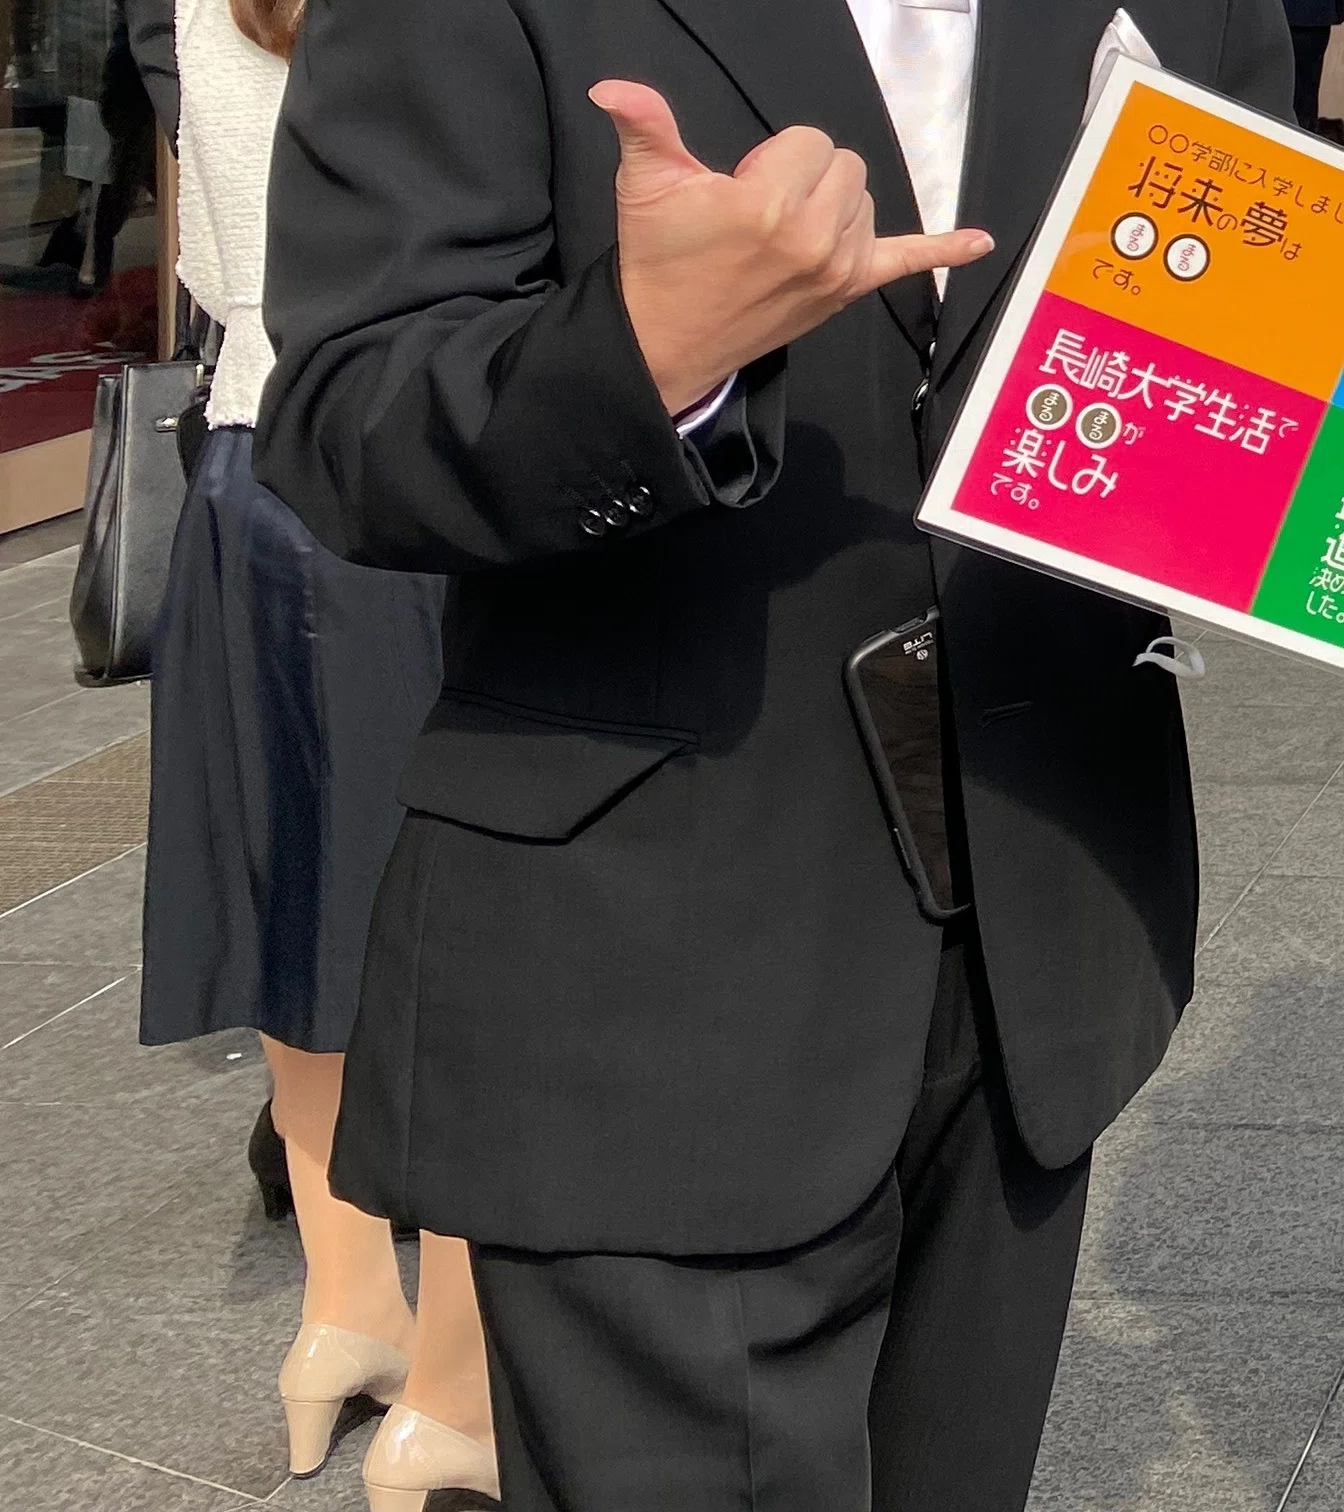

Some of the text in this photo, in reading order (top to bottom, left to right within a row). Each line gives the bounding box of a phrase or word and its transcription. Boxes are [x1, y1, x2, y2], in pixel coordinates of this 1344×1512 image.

[1127, 155, 1303, 262] 将来の夢は
[1091, 259, 1141, 296] です。
[1126, 223, 1197, 272] まる まる
[1038, 328, 1299, 456] 長崎大学生活で
[990, 472, 1040, 511] です。
[1001, 427, 1119, 499] 楽しみ
